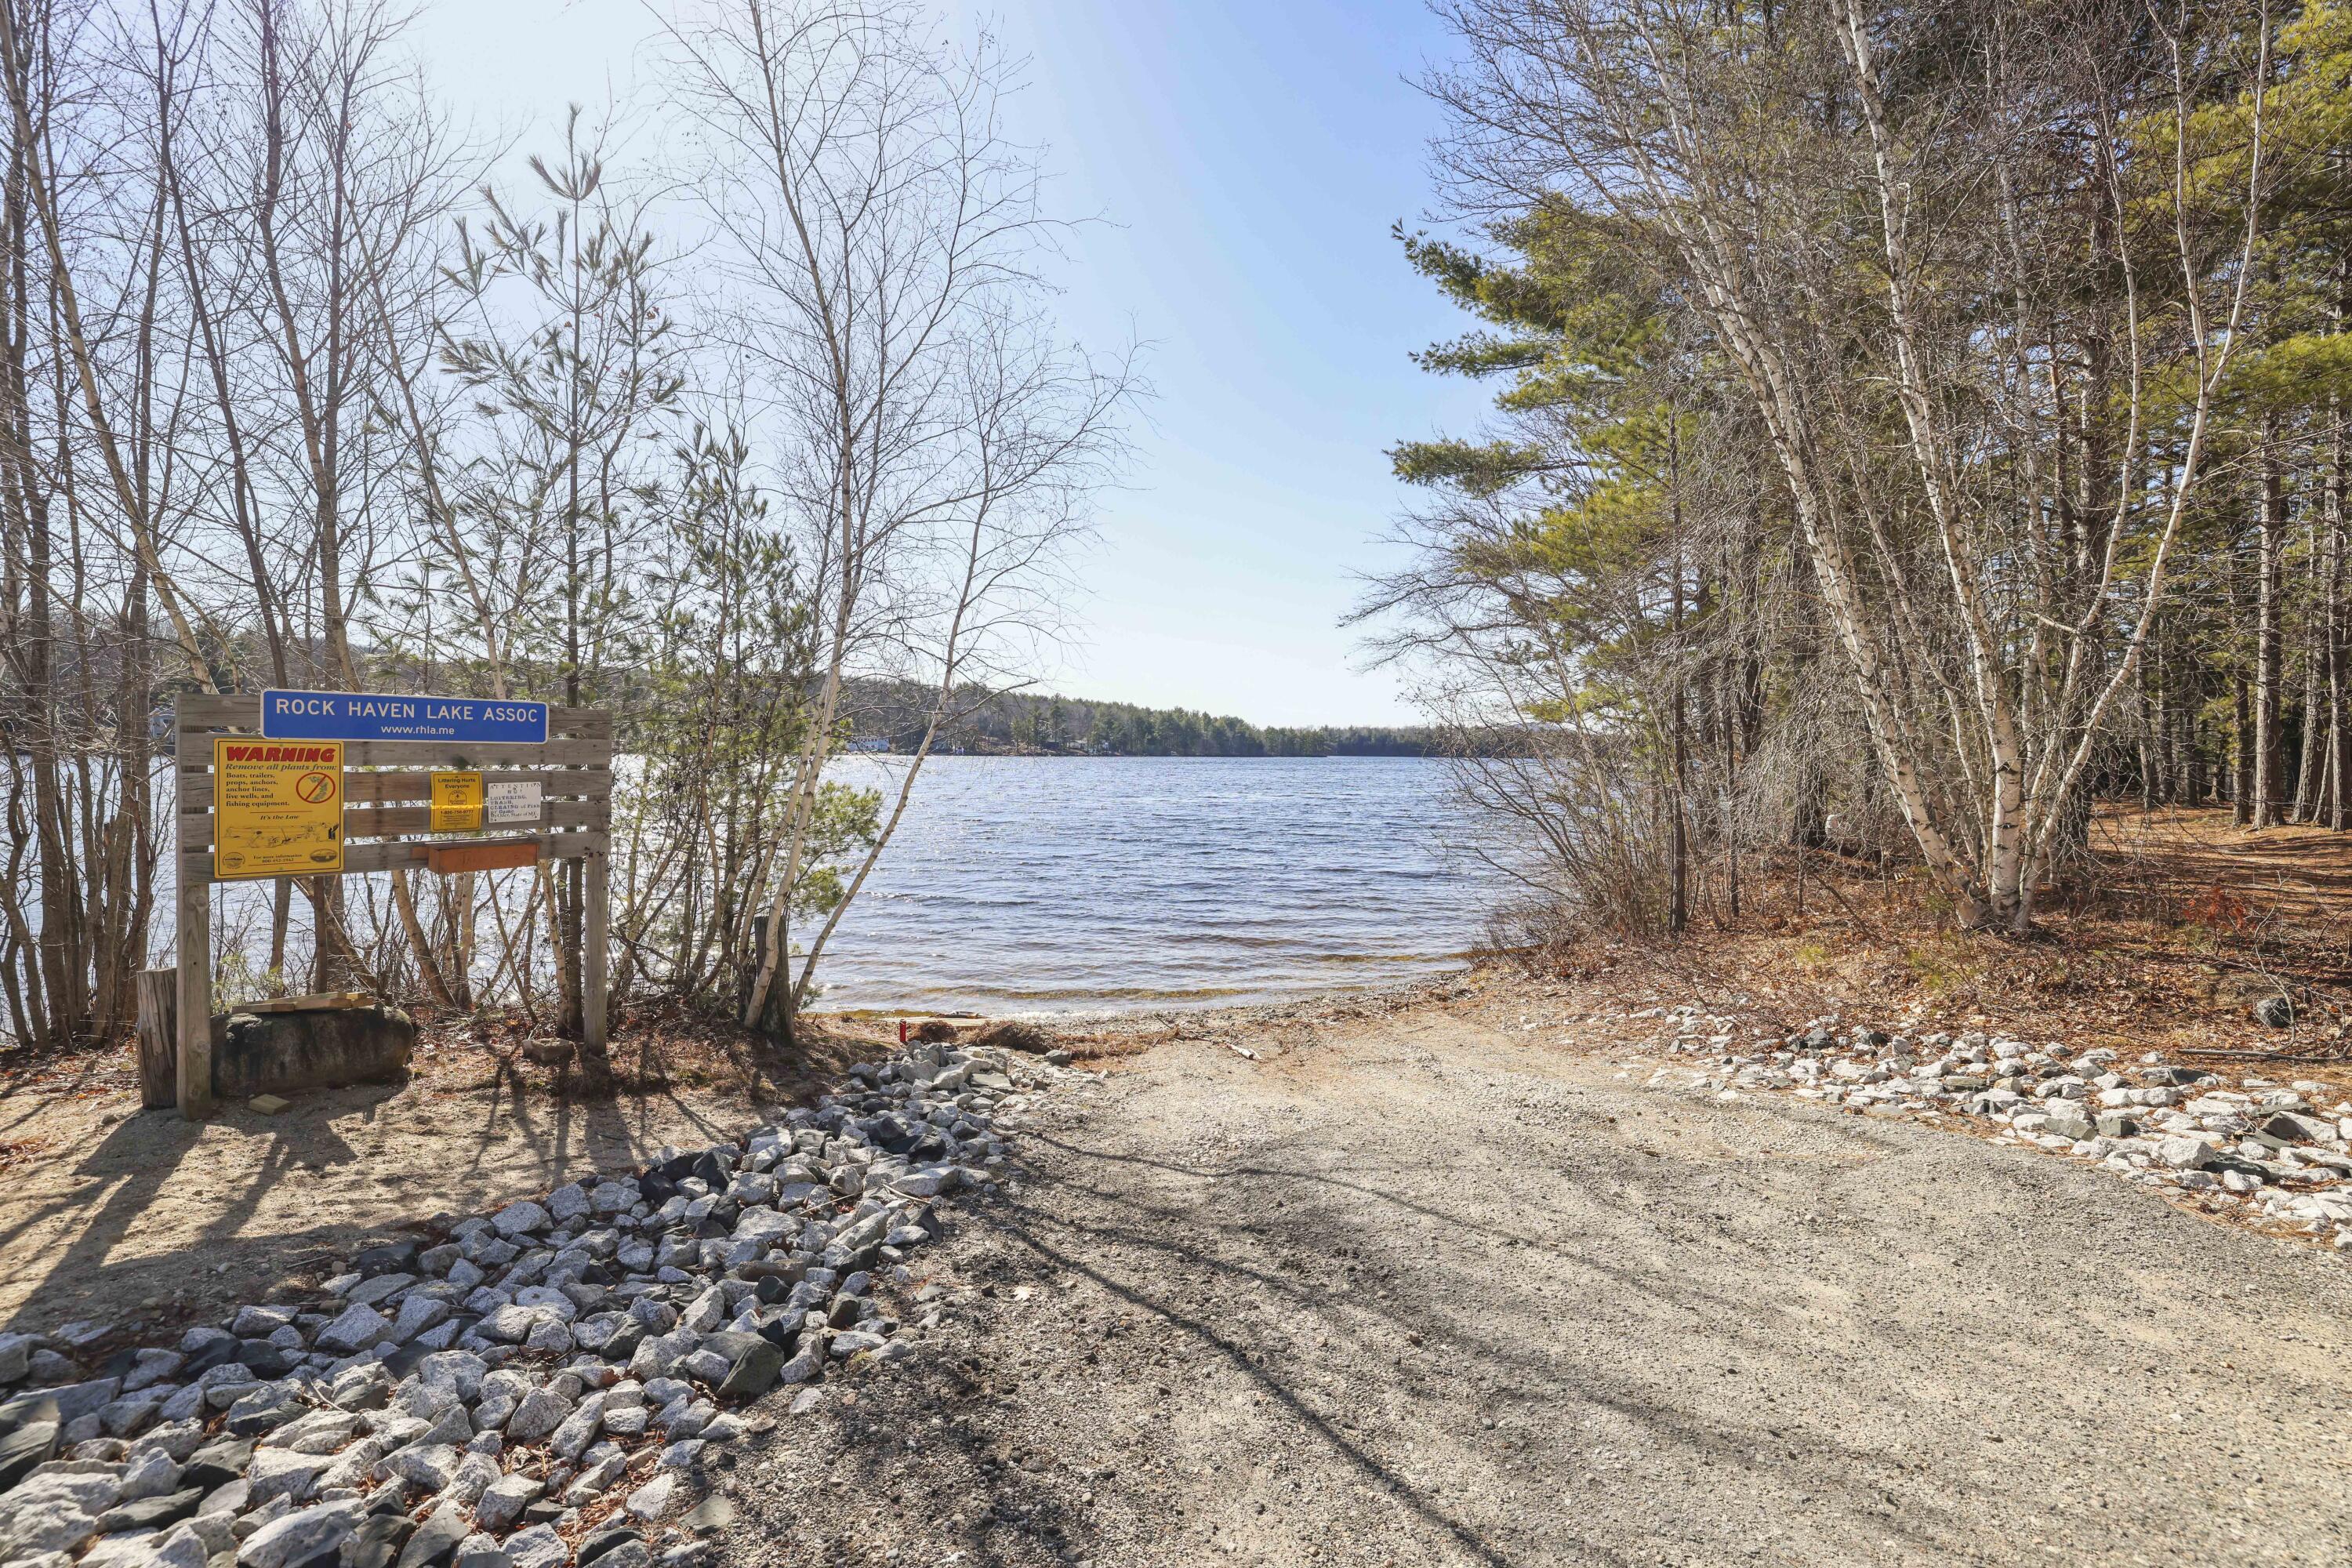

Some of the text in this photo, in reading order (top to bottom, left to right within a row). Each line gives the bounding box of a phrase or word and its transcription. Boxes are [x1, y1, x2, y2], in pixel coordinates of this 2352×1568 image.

[276, 698, 538, 723] ROCK HAVEN LAKE ASSOC
[381, 725, 455, 735] www.rhla.me
[226, 746, 336, 763] WARNING
[281, 764, 310, 772] plants
[310, 764, 337, 772] from:
